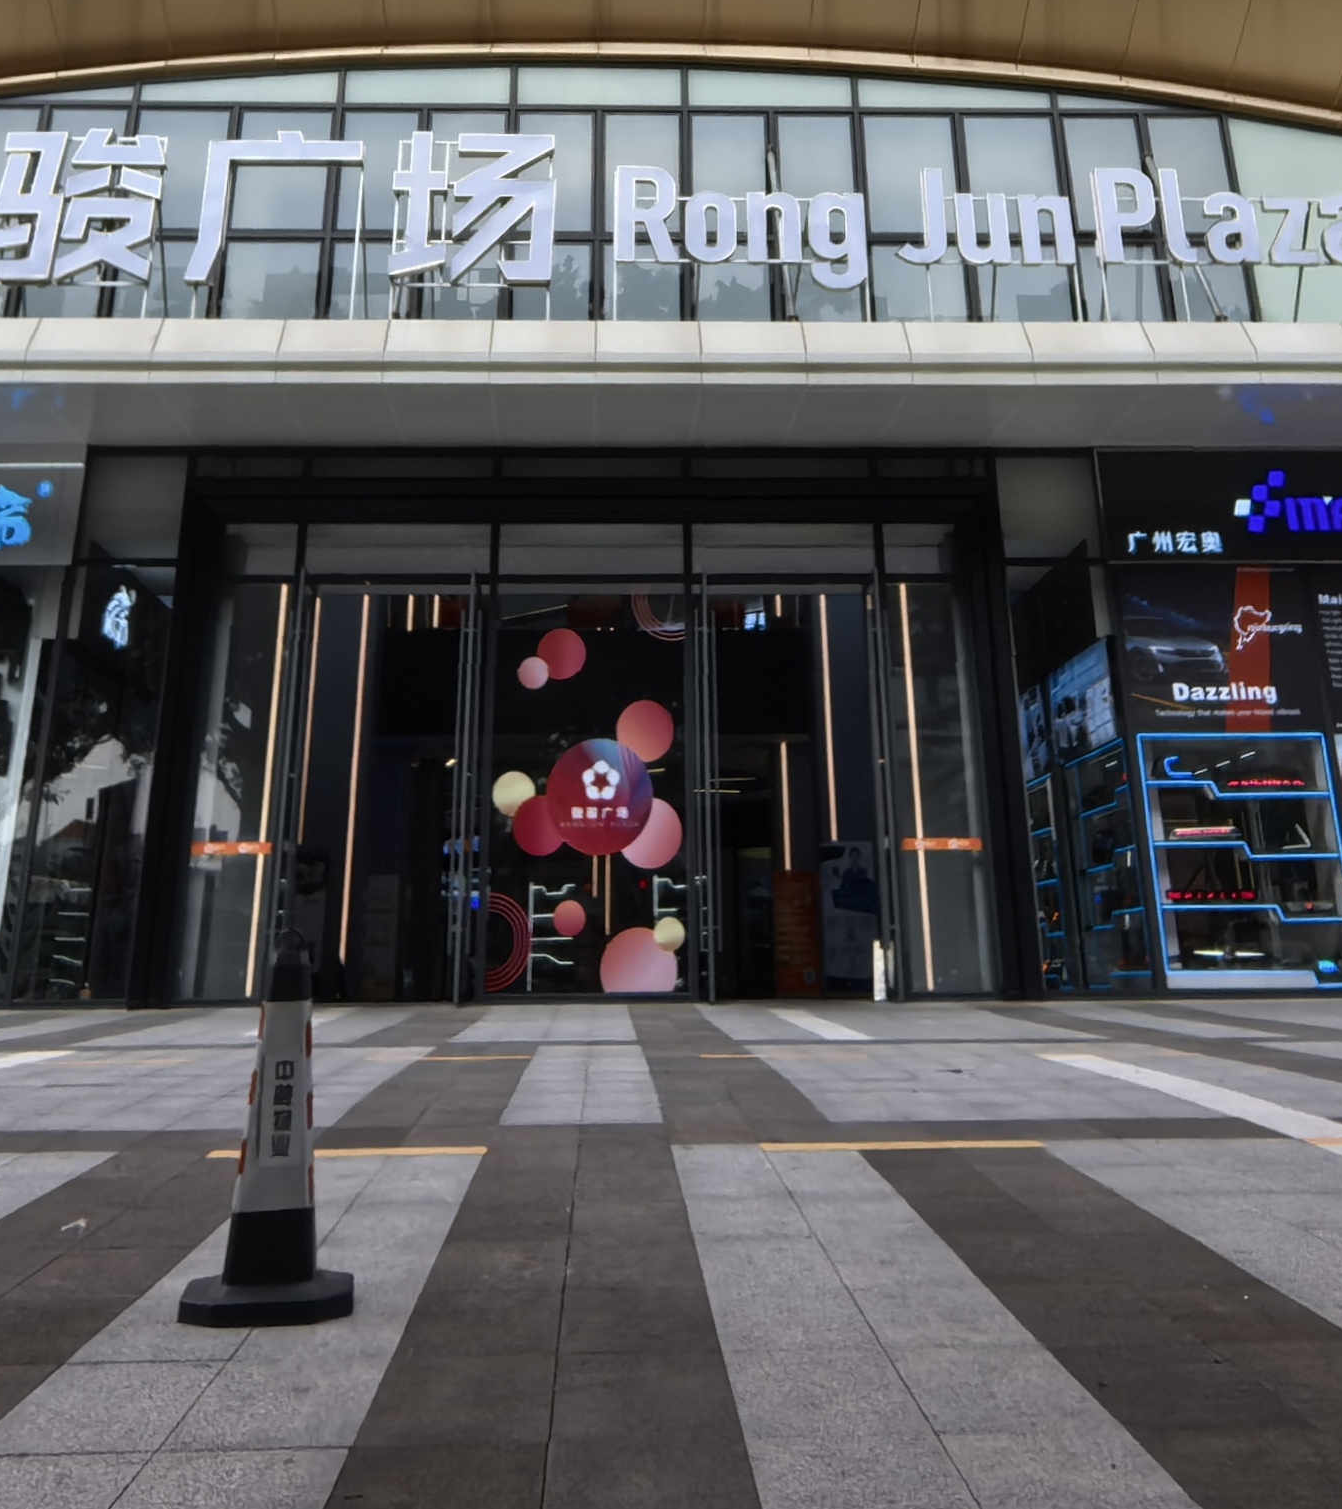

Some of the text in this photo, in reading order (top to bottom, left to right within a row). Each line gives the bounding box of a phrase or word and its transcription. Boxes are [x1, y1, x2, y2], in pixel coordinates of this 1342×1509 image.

[614, 165, 868, 290] Rong
[896, 166, 1077, 266] Jun
[1127, 531, 1224, 555] 广州宏奥
[1171, 681, 1278, 704] Dazzling
